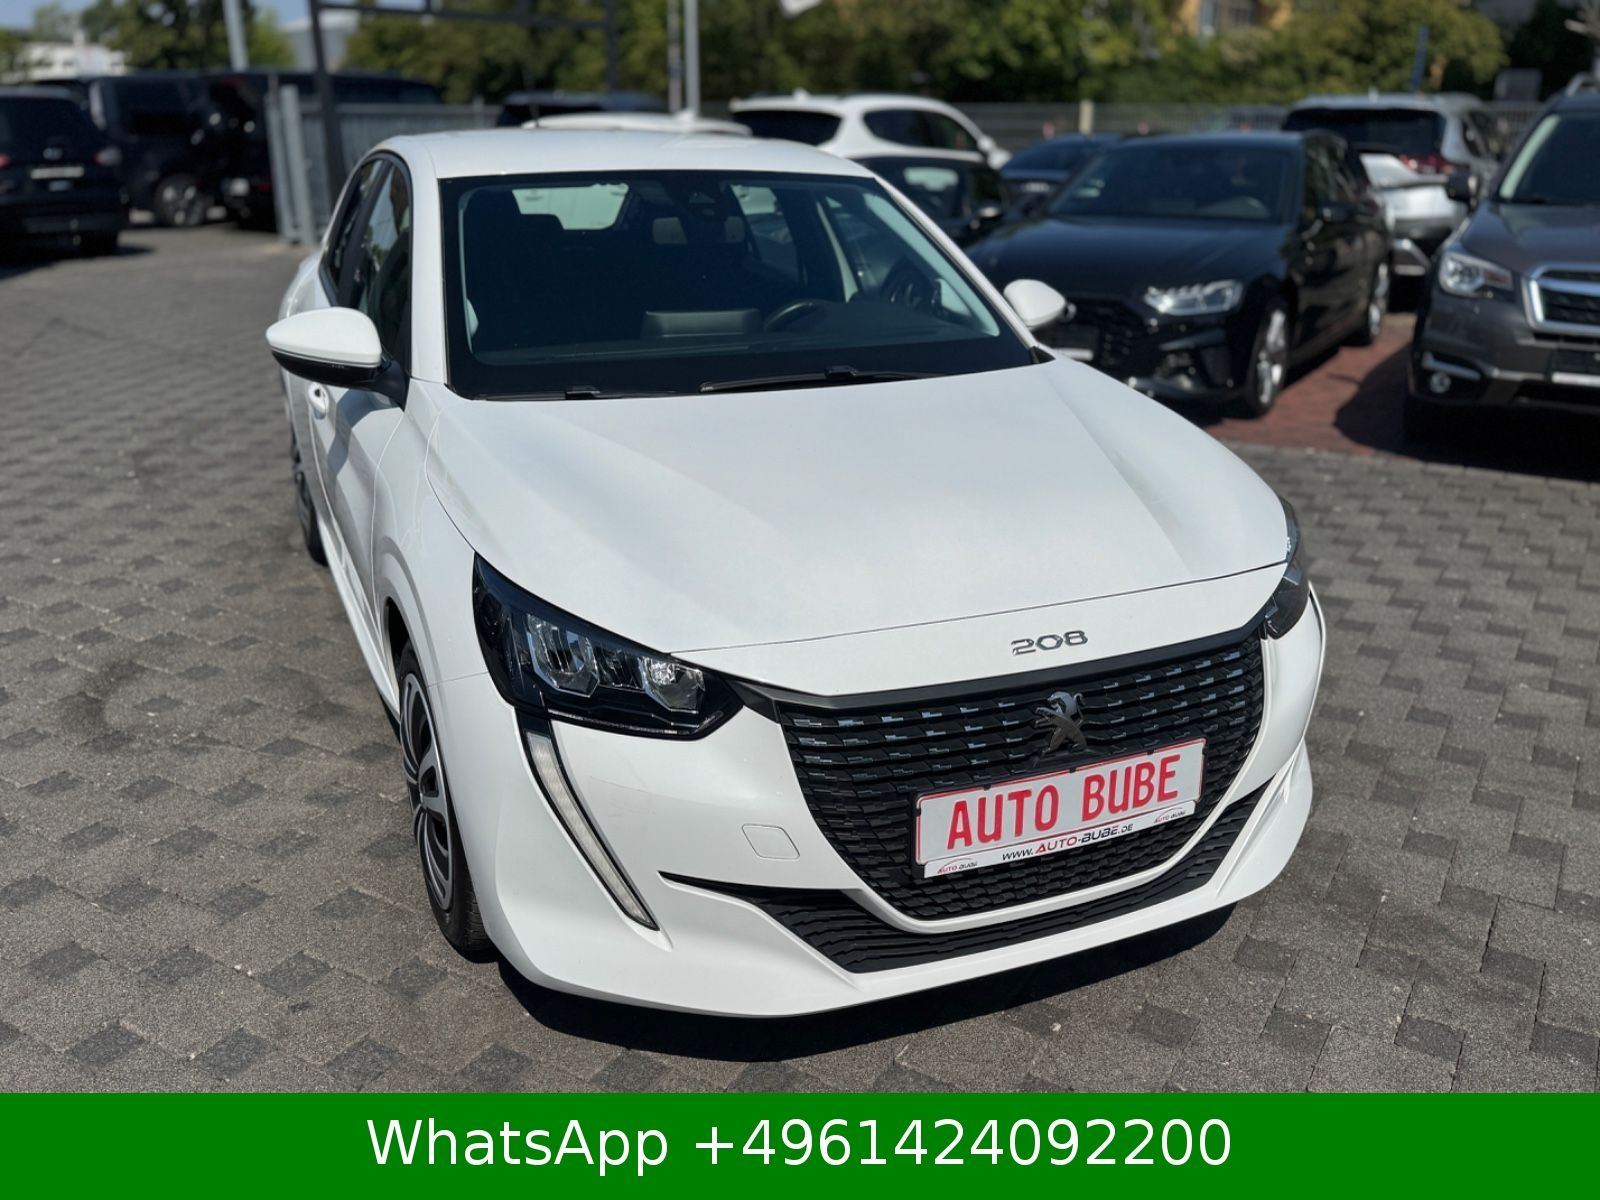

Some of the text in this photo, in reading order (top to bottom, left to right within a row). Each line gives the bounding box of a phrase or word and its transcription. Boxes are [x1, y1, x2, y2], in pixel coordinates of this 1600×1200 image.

[1011, 630, 1088, 655] 208
[947, 754, 1181, 849] AUTO BUBE
